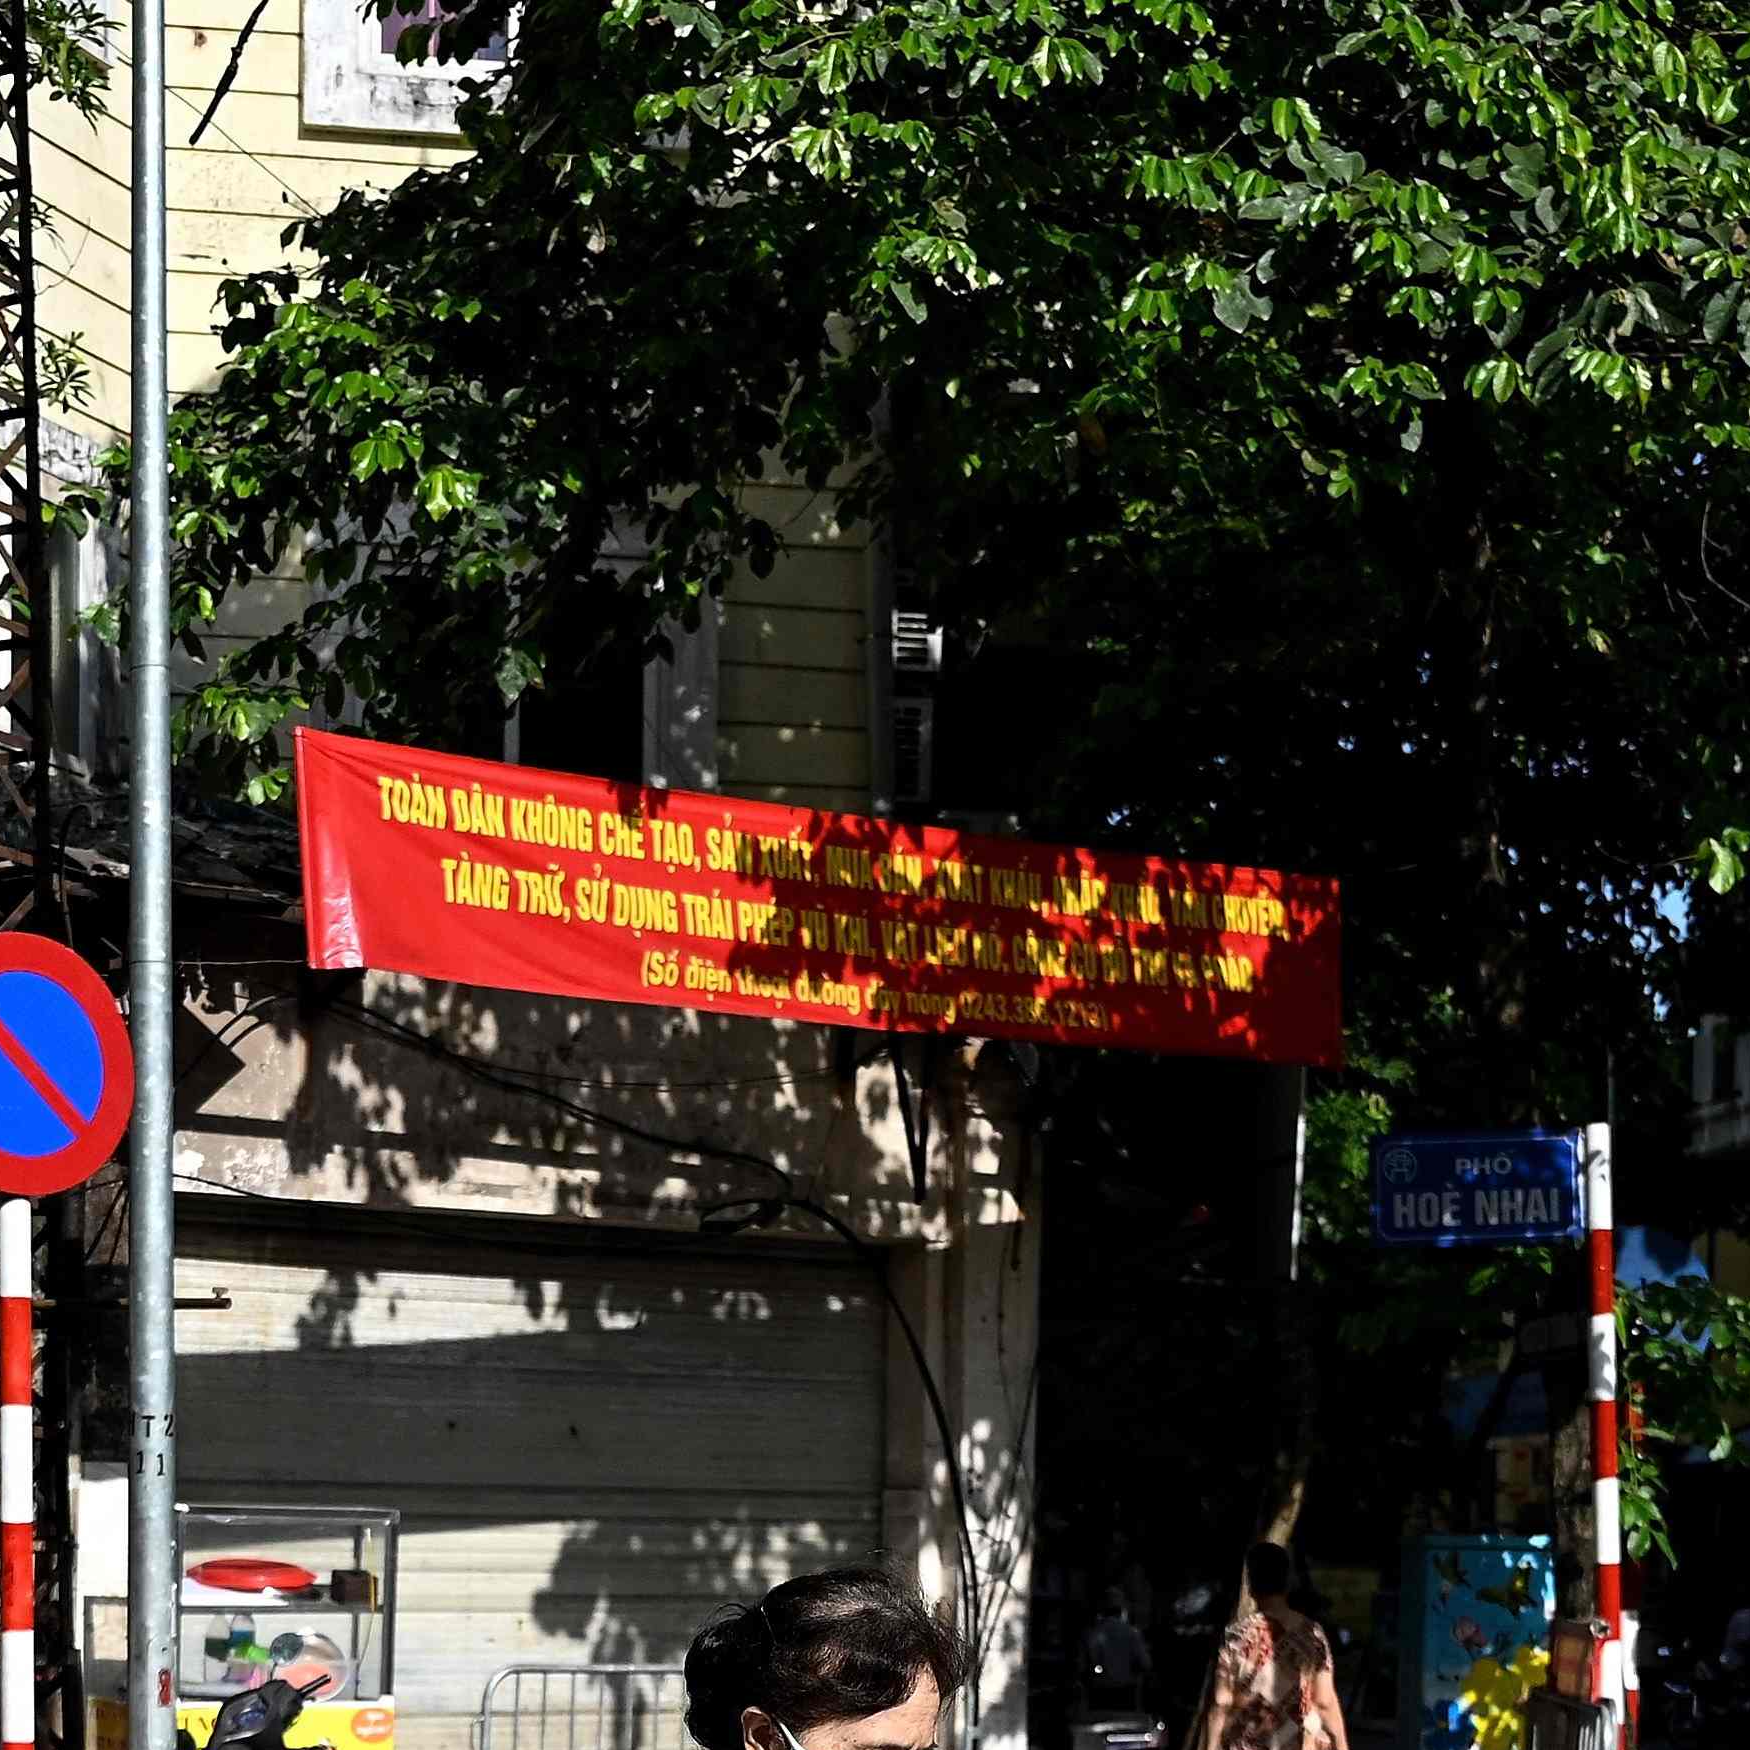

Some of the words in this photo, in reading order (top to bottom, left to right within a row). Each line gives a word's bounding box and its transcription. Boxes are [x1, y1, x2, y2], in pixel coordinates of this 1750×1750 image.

[377, 772, 447, 830] TOÀN
[451, 783, 506, 838] DÂN
[511, 795, 593, 853] KHÔNG
[599, 807, 646, 860] CHẾ
[648, 820, 701, 873] TẠO,
[706, 812, 753, 874] SẢN
[825, 844, 874, 890] MUA
[440, 851, 511, 911] TÀNG
[514, 863, 572, 924] TRỮ,
[574, 863, 611, 924] SỬ
[612, 884, 679, 939] DỤNG
[681, 888, 735, 941] TRÁI
[737, 895, 795, 949] PHÉP
[640, 949, 679, 989] (Số
[684, 956, 732, 1001] điện
[738, 962, 792, 1009] thoại
[796, 963, 861, 1015] đường
[1454, 1150, 1513, 1176] PHỐ
[1392, 1181, 1464, 1230] HOÈ
[1473, 1187, 1561, 1226] NHAI
